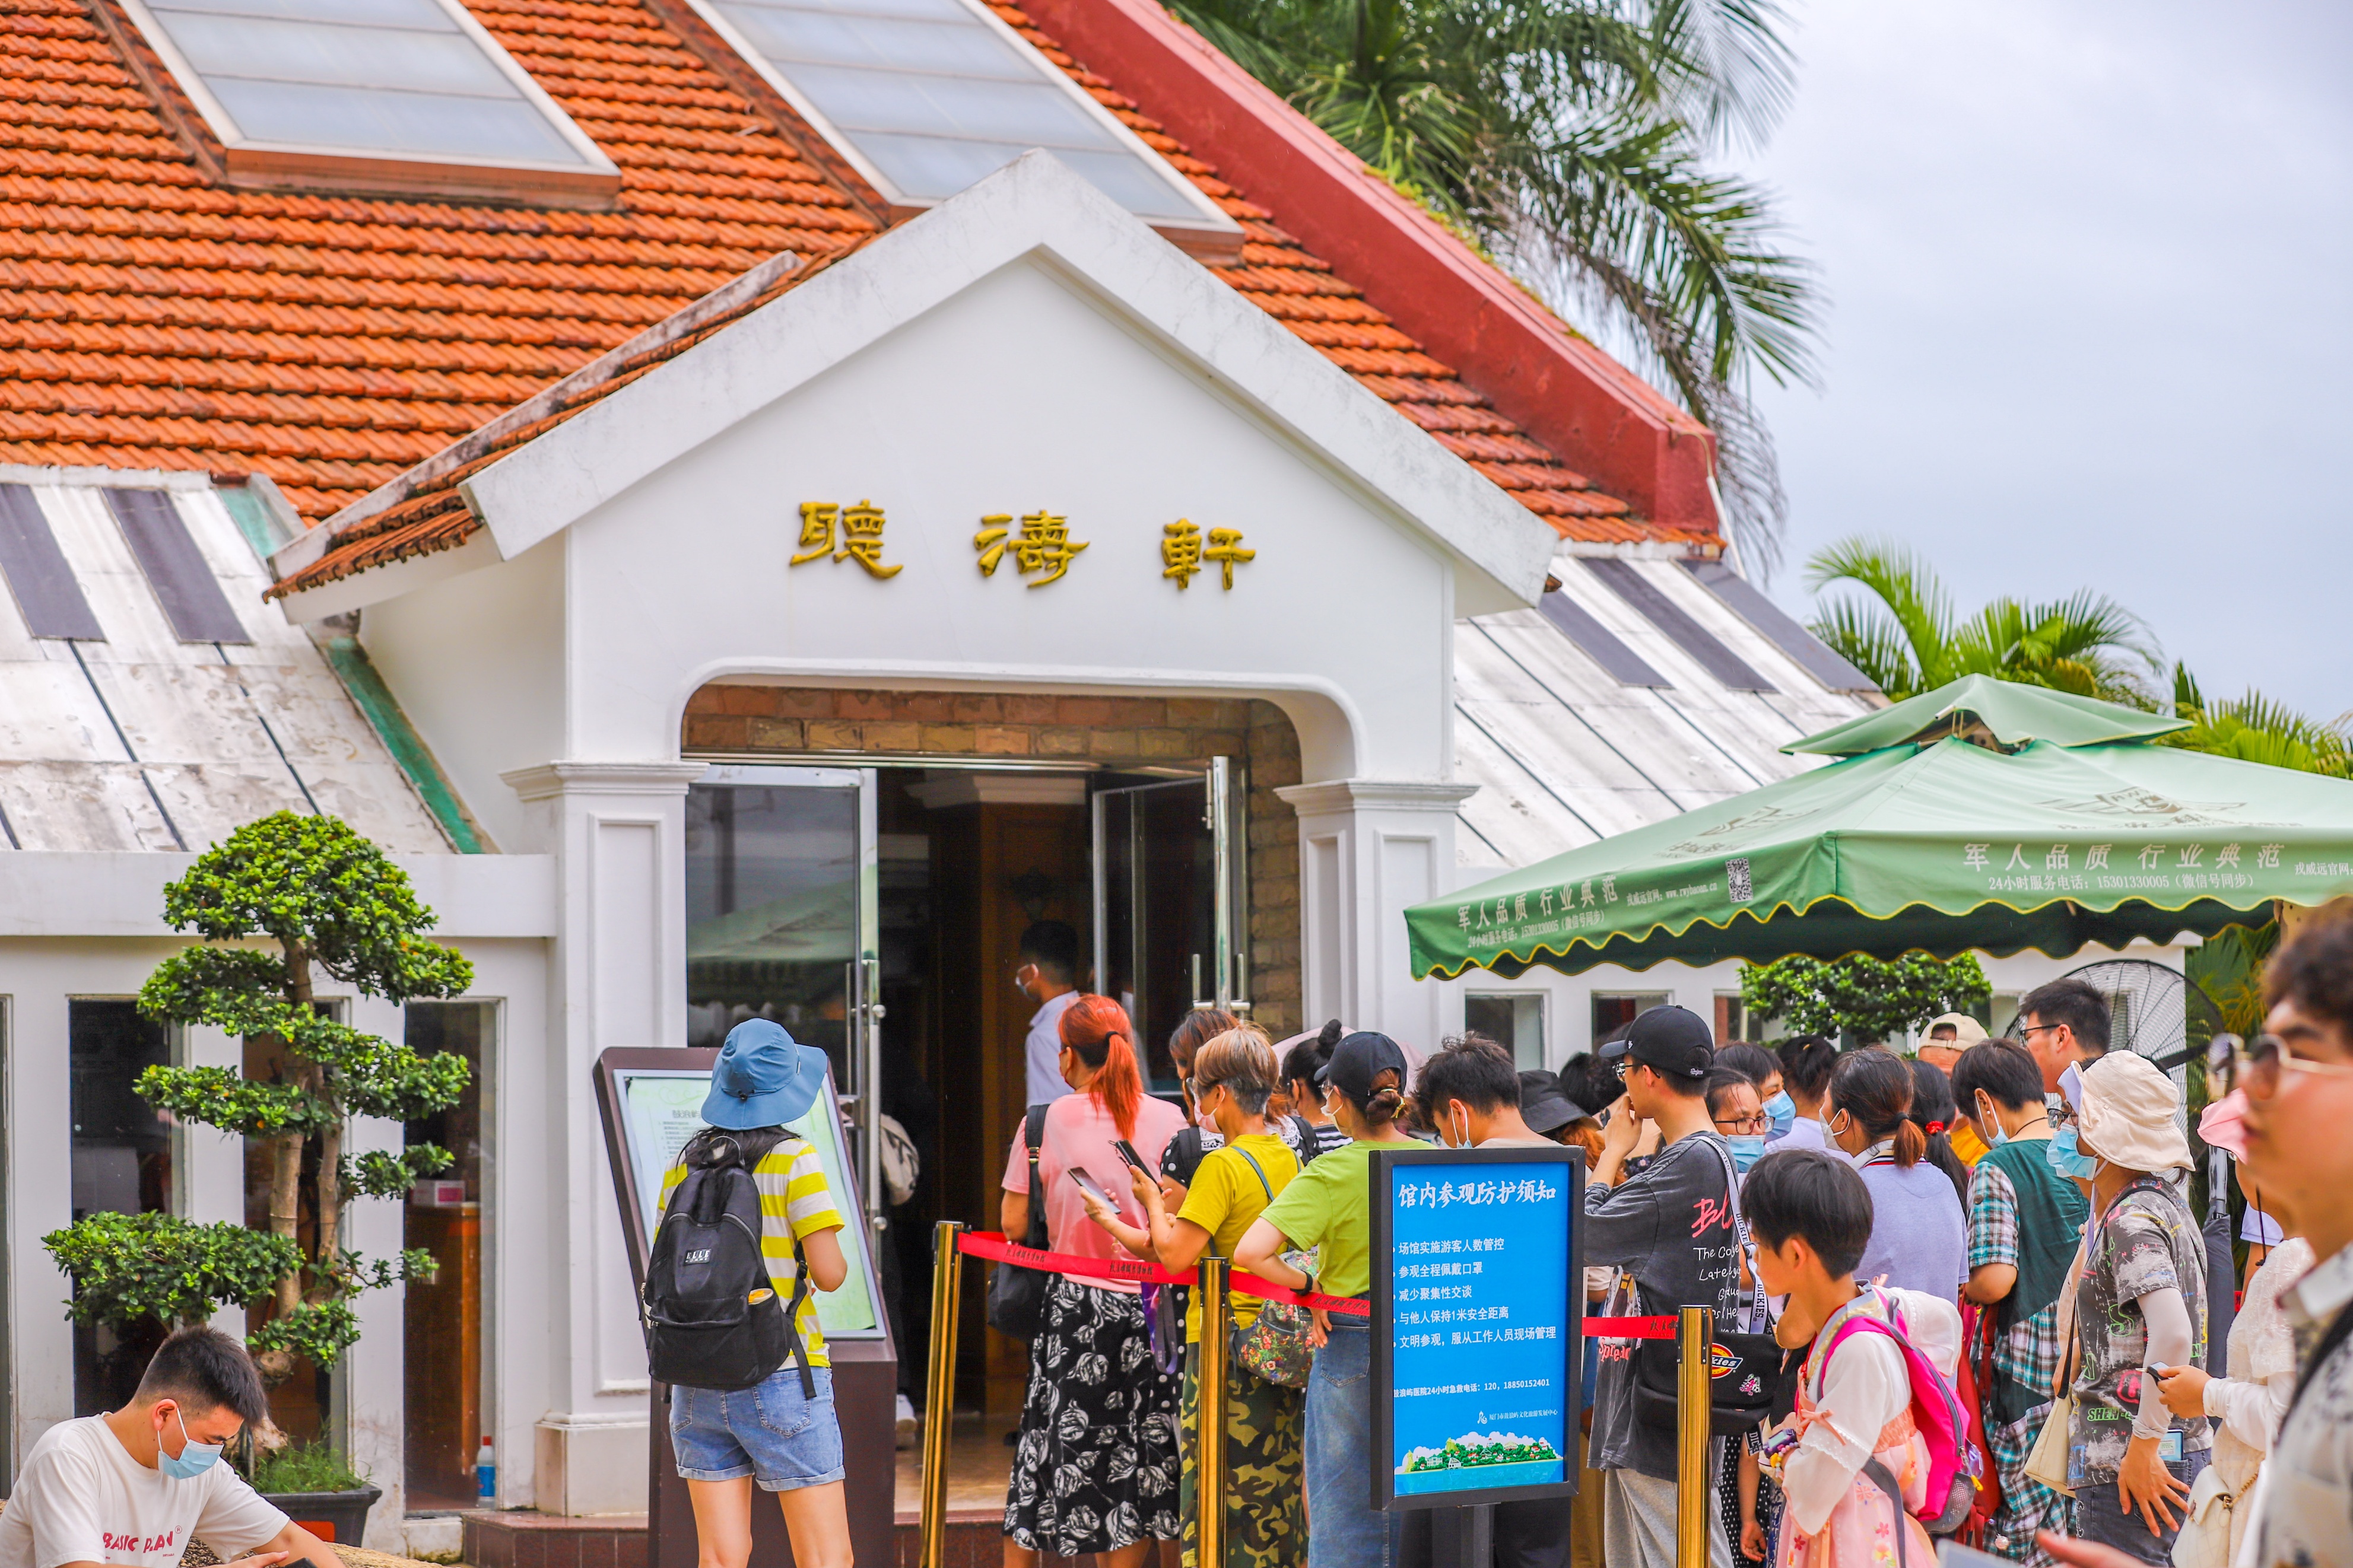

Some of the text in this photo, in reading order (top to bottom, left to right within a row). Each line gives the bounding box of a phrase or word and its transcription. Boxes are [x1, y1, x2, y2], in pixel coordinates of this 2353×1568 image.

[1963, 842, 2285, 872] 军人品质 行业典范
[1457, 874, 1618, 933] 军人品质 行业典范
[1398, 1179, 1557, 1209] 馆内参观防护须知
[686, 1249, 710, 1260] ELLE
[1399, 1238, 1504, 1255] 场馆实施游客人数管控
[1693, 1246, 1716, 1261] The
[1399, 1261, 1483, 1278] 参观全程佩戴口罩
[1399, 1285, 1472, 1302] 减少聚集性交谈
[1399, 1306, 1509, 1325] 与他人保持1米安全距离
[103, 1532, 139, 1552] BASIC
